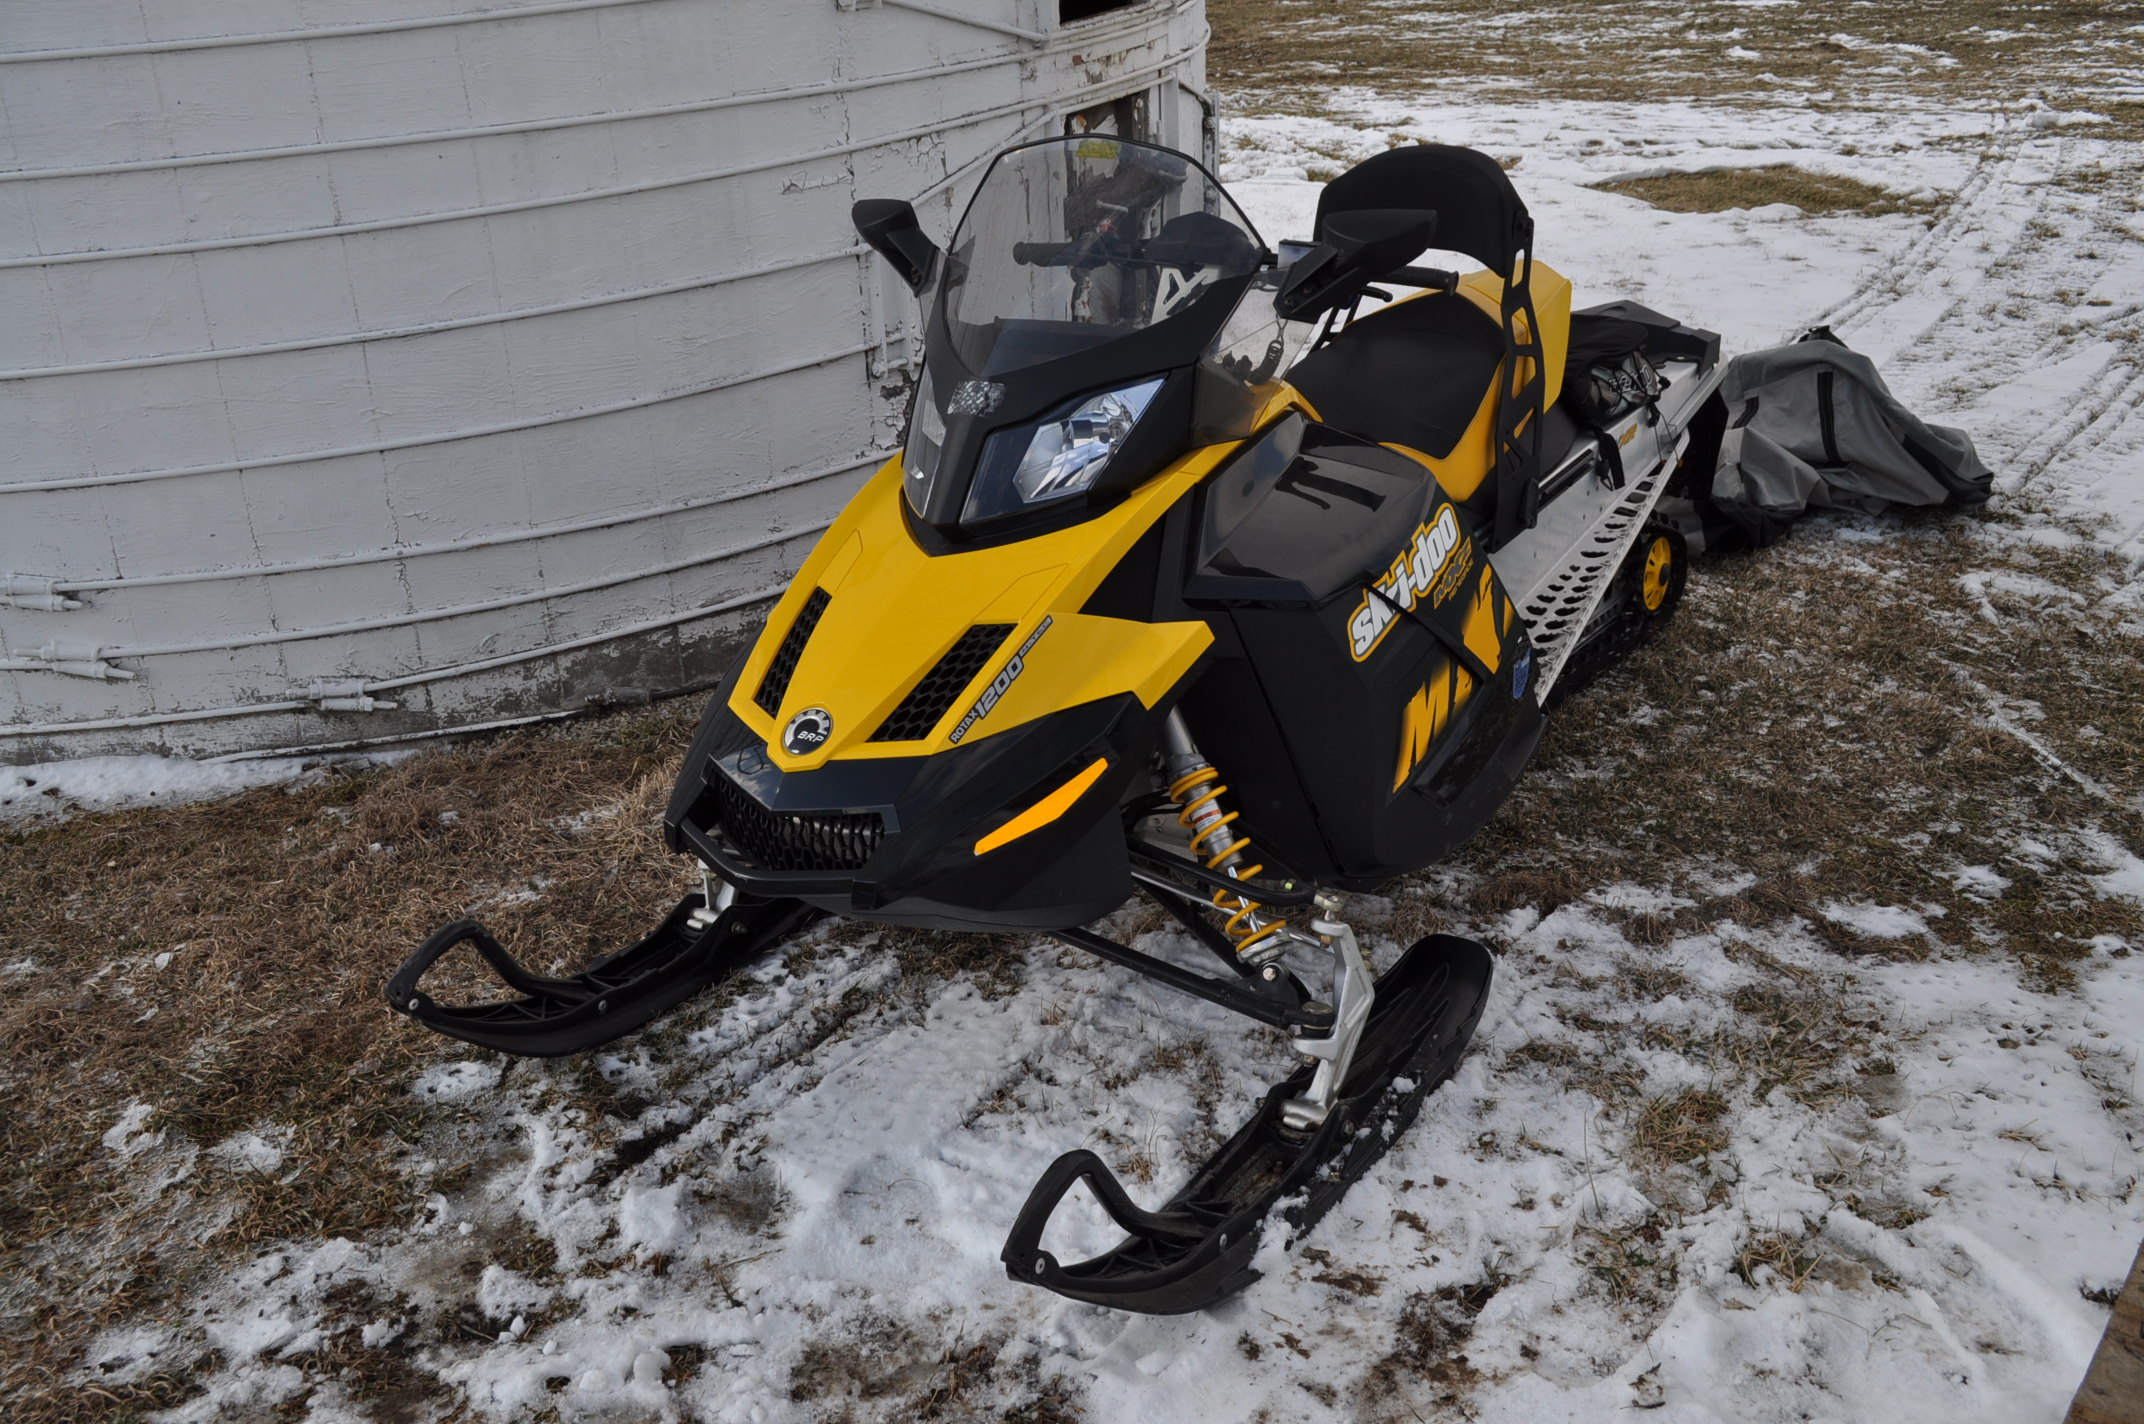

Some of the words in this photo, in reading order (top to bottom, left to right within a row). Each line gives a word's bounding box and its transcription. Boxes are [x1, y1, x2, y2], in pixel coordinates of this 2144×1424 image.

[950, 708, 978, 743] ROTAX
[974, 655, 1024, 719] 1200
[797, 730, 825, 743] BRP
